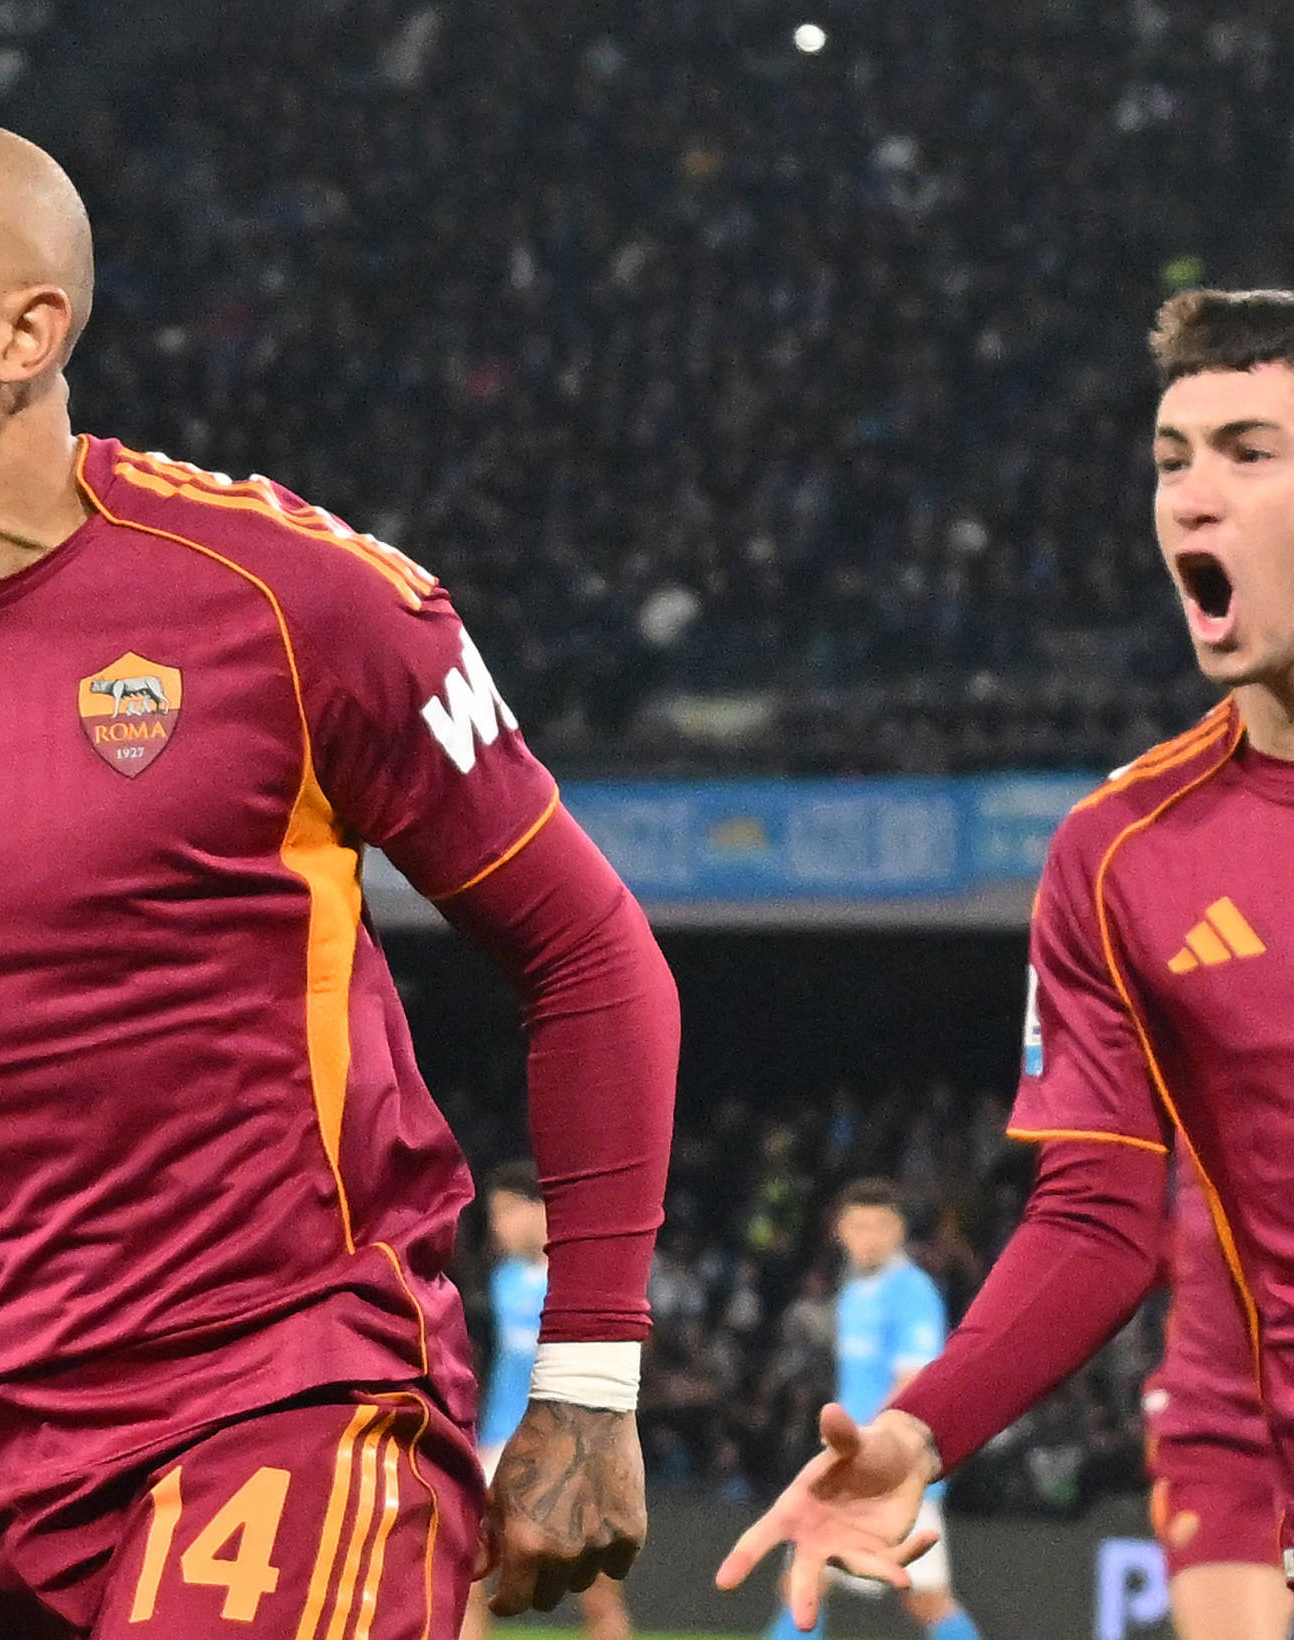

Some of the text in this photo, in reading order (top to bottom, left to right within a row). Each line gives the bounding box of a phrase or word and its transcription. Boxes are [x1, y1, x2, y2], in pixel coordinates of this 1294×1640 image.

[94, 720, 168, 745] ROMA
[116, 746, 146, 760] 1927
[128, 1465, 293, 1624] 14
